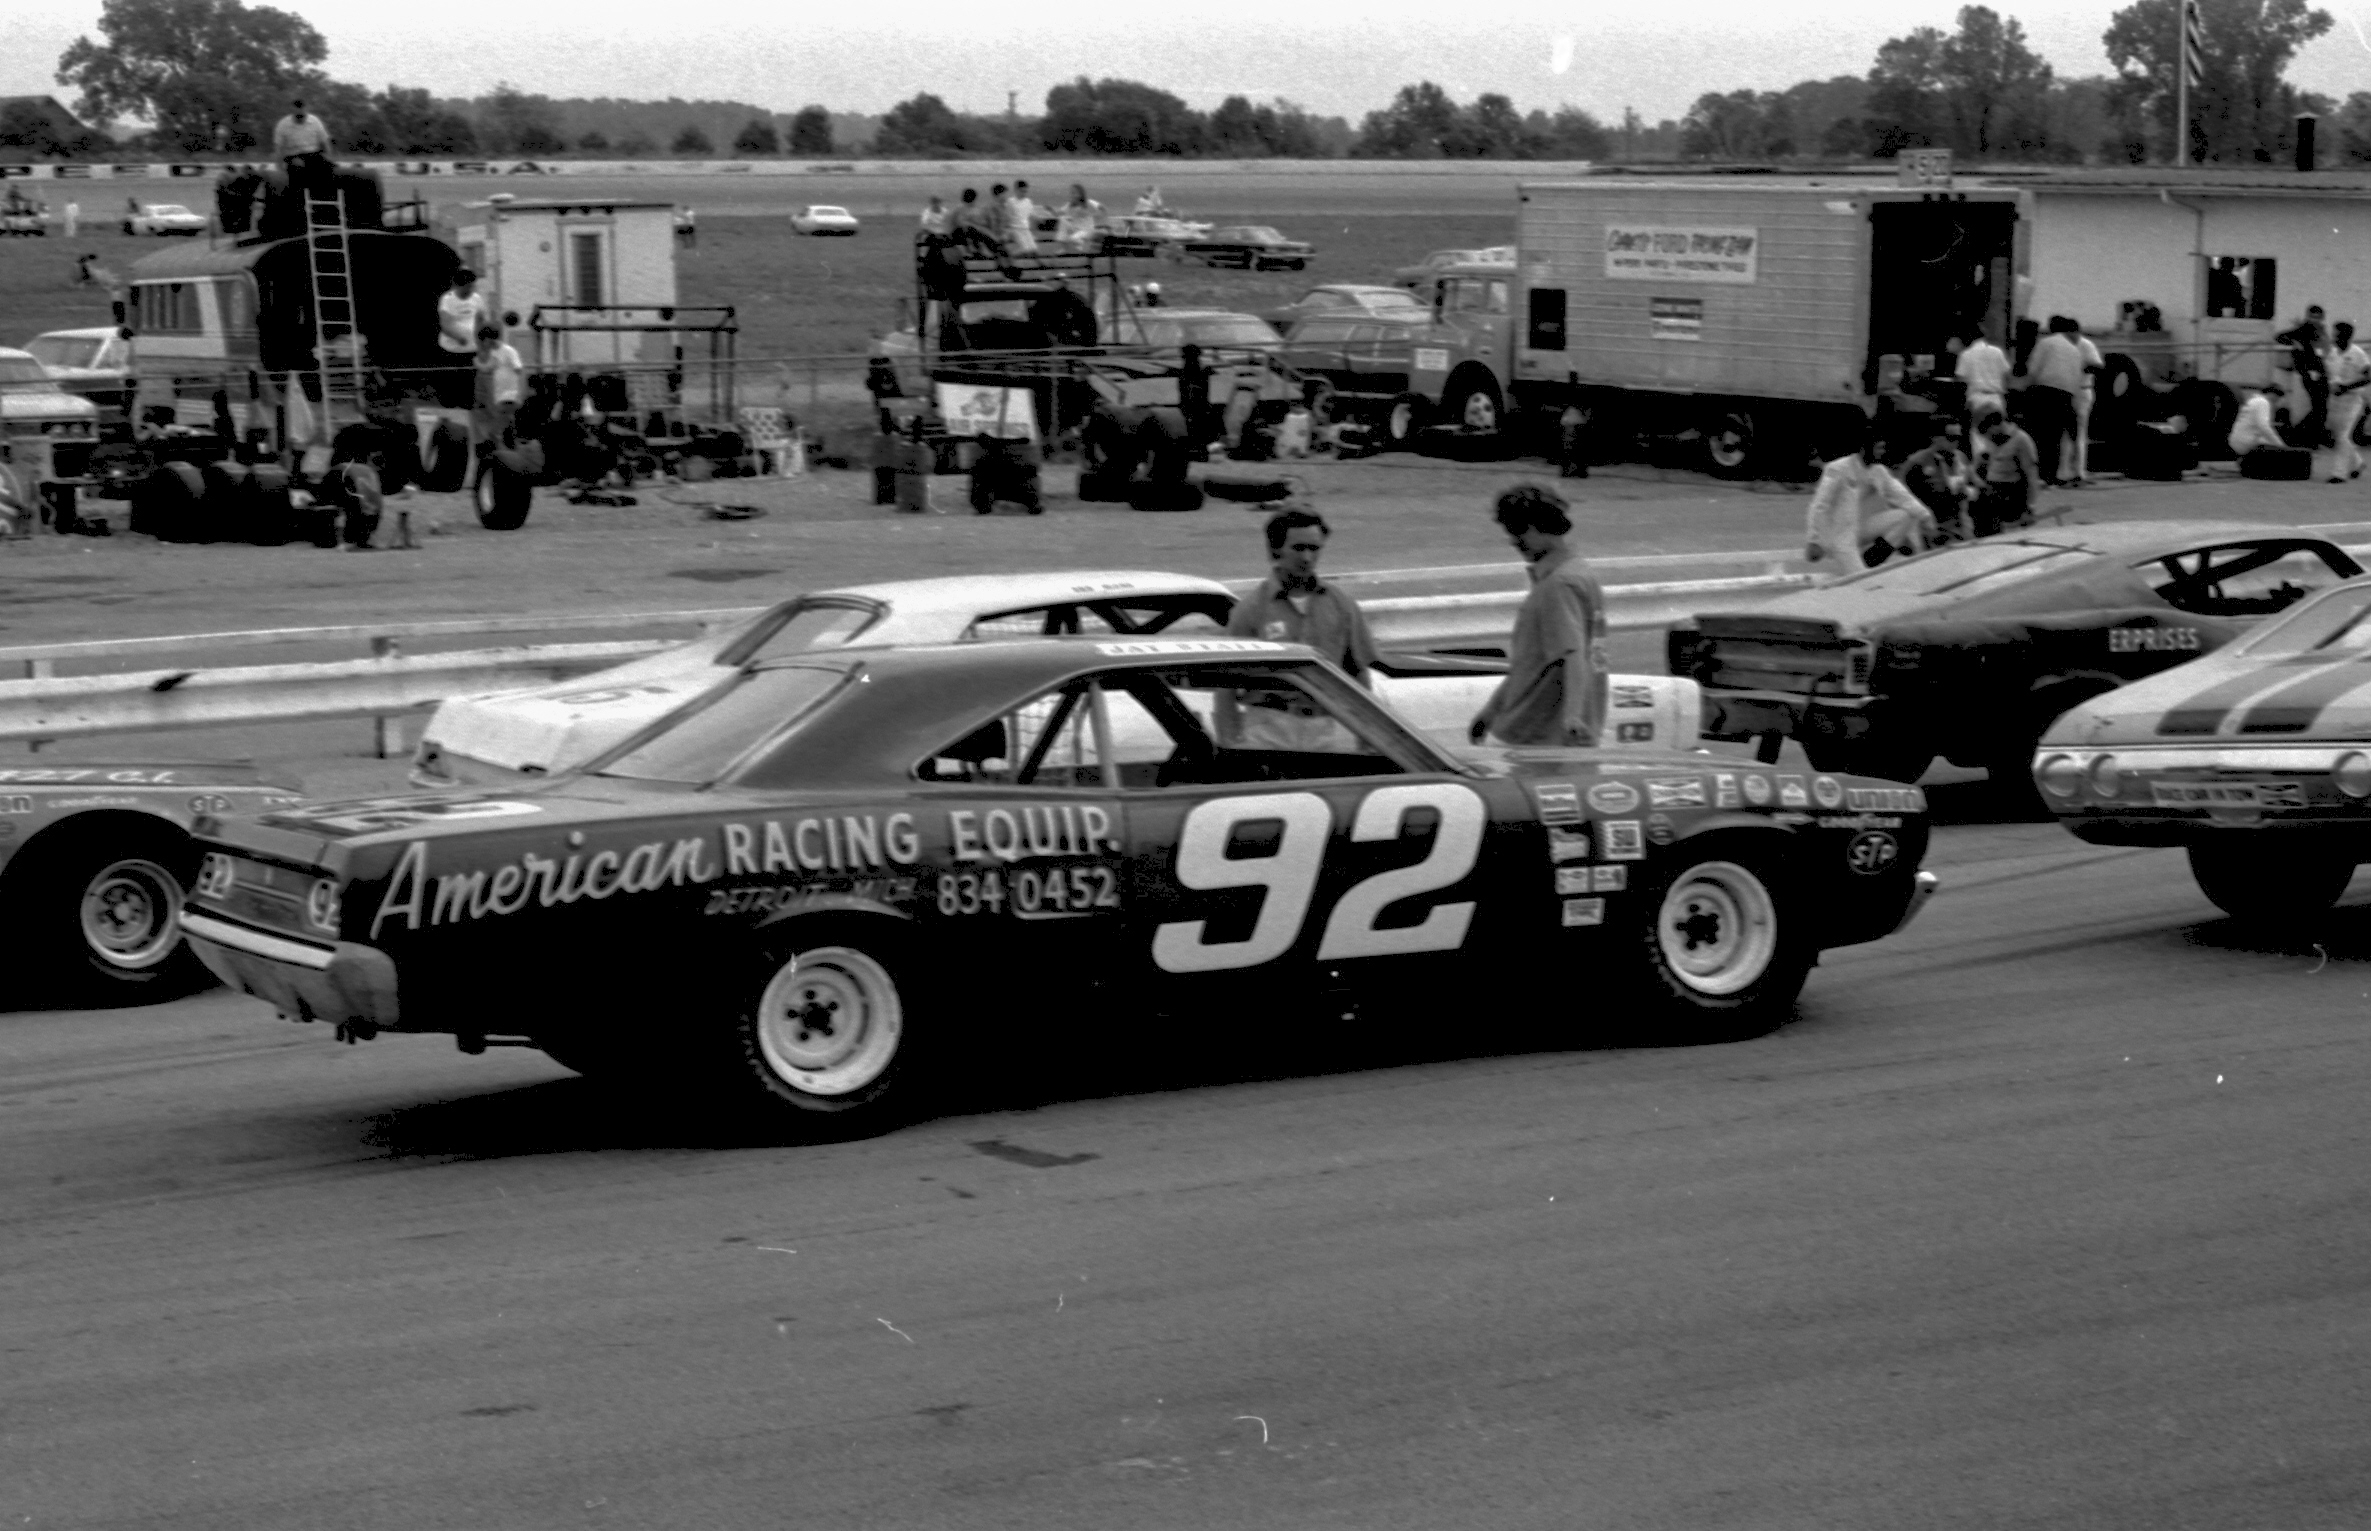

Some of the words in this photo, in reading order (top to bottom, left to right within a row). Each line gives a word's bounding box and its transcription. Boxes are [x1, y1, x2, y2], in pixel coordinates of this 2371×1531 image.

[2109, 627, 2199, 652] ERPRISES
[1851, 835, 1898, 868] STP
[369, 830, 716, 940] American
[723, 812, 920, 875] RACING
[948, 805, 1122, 863] EQUIP.
[936, 872, 1005, 916] 834
[1015, 866, 1121, 912] 0452
[1151, 784, 1487, 974] 92
[704, 883, 829, 915] DETROIT
